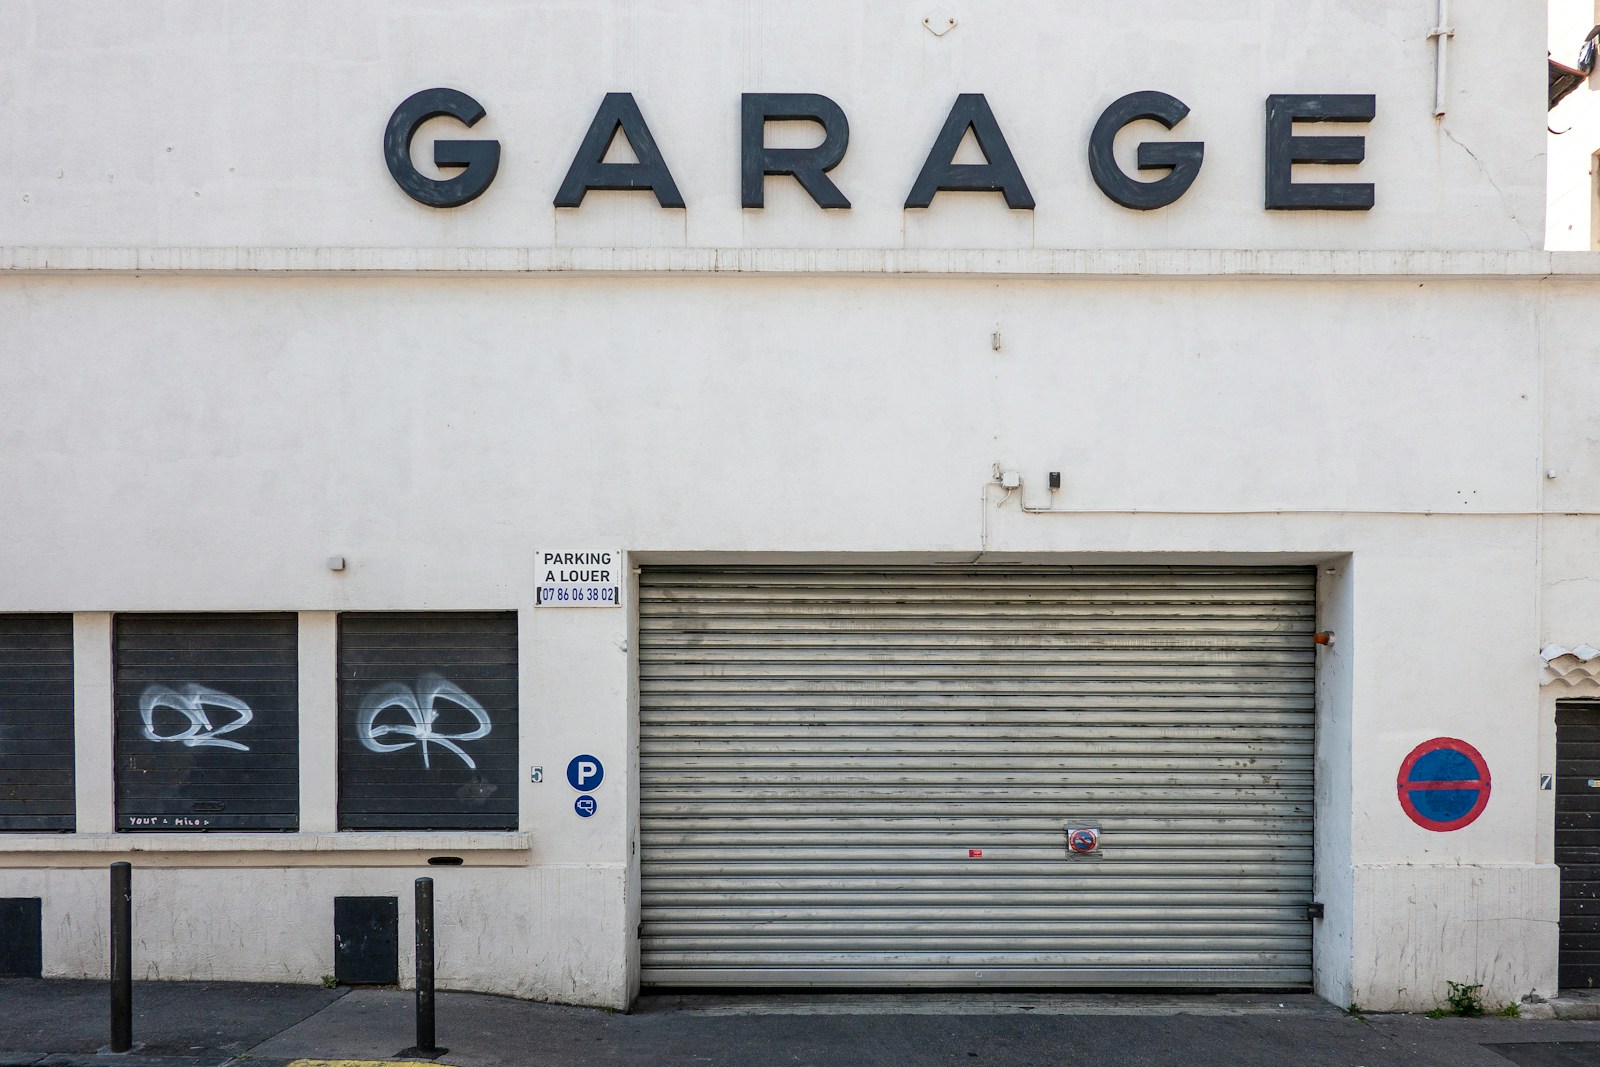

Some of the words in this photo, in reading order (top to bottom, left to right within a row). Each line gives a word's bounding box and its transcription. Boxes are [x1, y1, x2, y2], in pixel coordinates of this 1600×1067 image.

[384, 87, 1376, 211] GARAGE
[544, 553, 611, 565] PARKING
[545, 570, 556, 582] A
[560, 570, 610, 582] LOUER
[542, 588, 555, 601] 07
[557, 588, 569, 601] 86
[572, 588, 584, 601] 06
[586, 588, 599, 601] 38
[601, 588, 613, 601] 02
[531, 766, 542, 783] 5
[578, 761, 597, 785] P
[1541, 774, 1552, 790] 7
